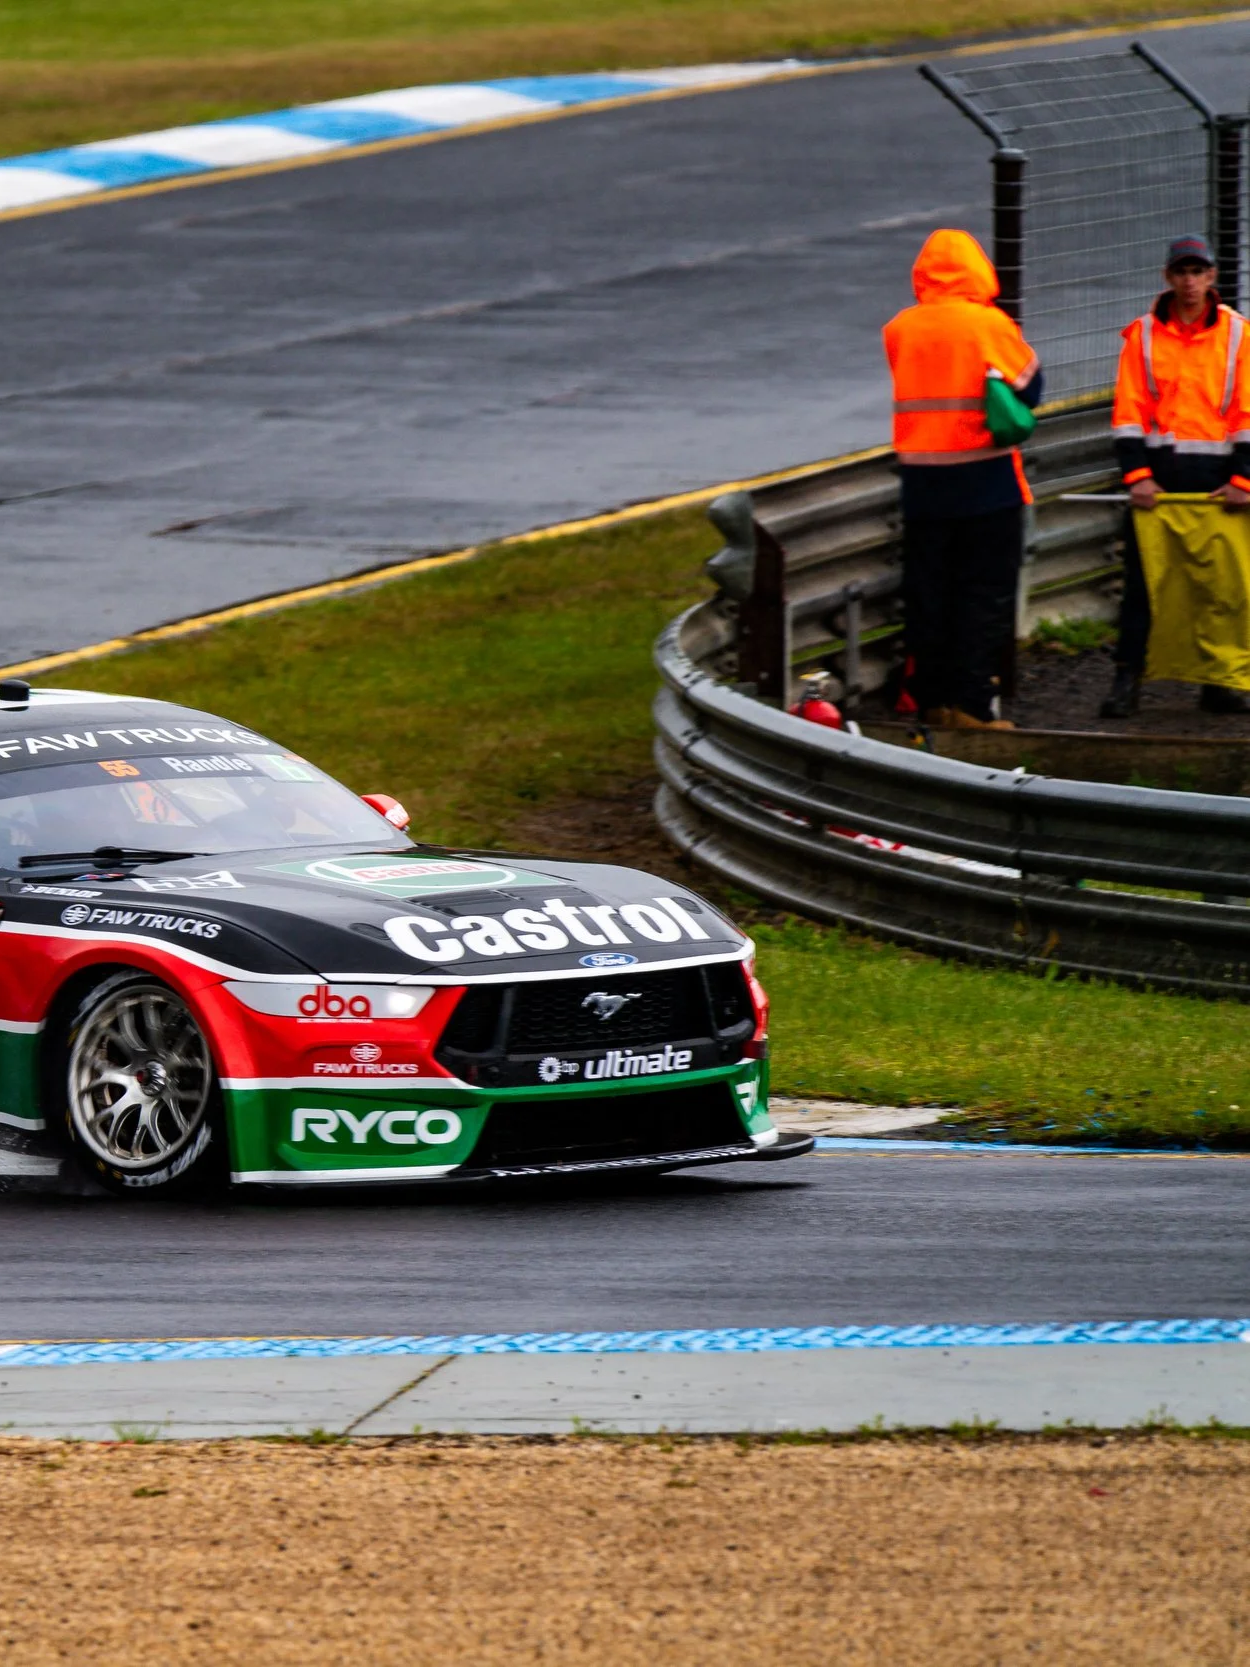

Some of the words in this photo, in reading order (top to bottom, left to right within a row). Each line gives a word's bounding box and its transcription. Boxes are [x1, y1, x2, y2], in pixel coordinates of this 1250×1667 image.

[97, 727, 270, 747] TRUCKS
[98, 759, 141, 778] 55
[160, 756, 252, 774] Randle
[353, 862, 482, 881] Castrol
[87, 908, 140, 926] FAW
[139, 912, 222, 939] TRUCKS
[383, 897, 711, 962] Castrol
[591, 953, 627, 968] Ford
[297, 985, 372, 1018] dba
[313, 1062, 352, 1074] FAW
[352, 1063, 419, 1075] TRUCKS
[584, 1045, 693, 1079] ultimate
[291, 1108, 462, 1145] RYCO
